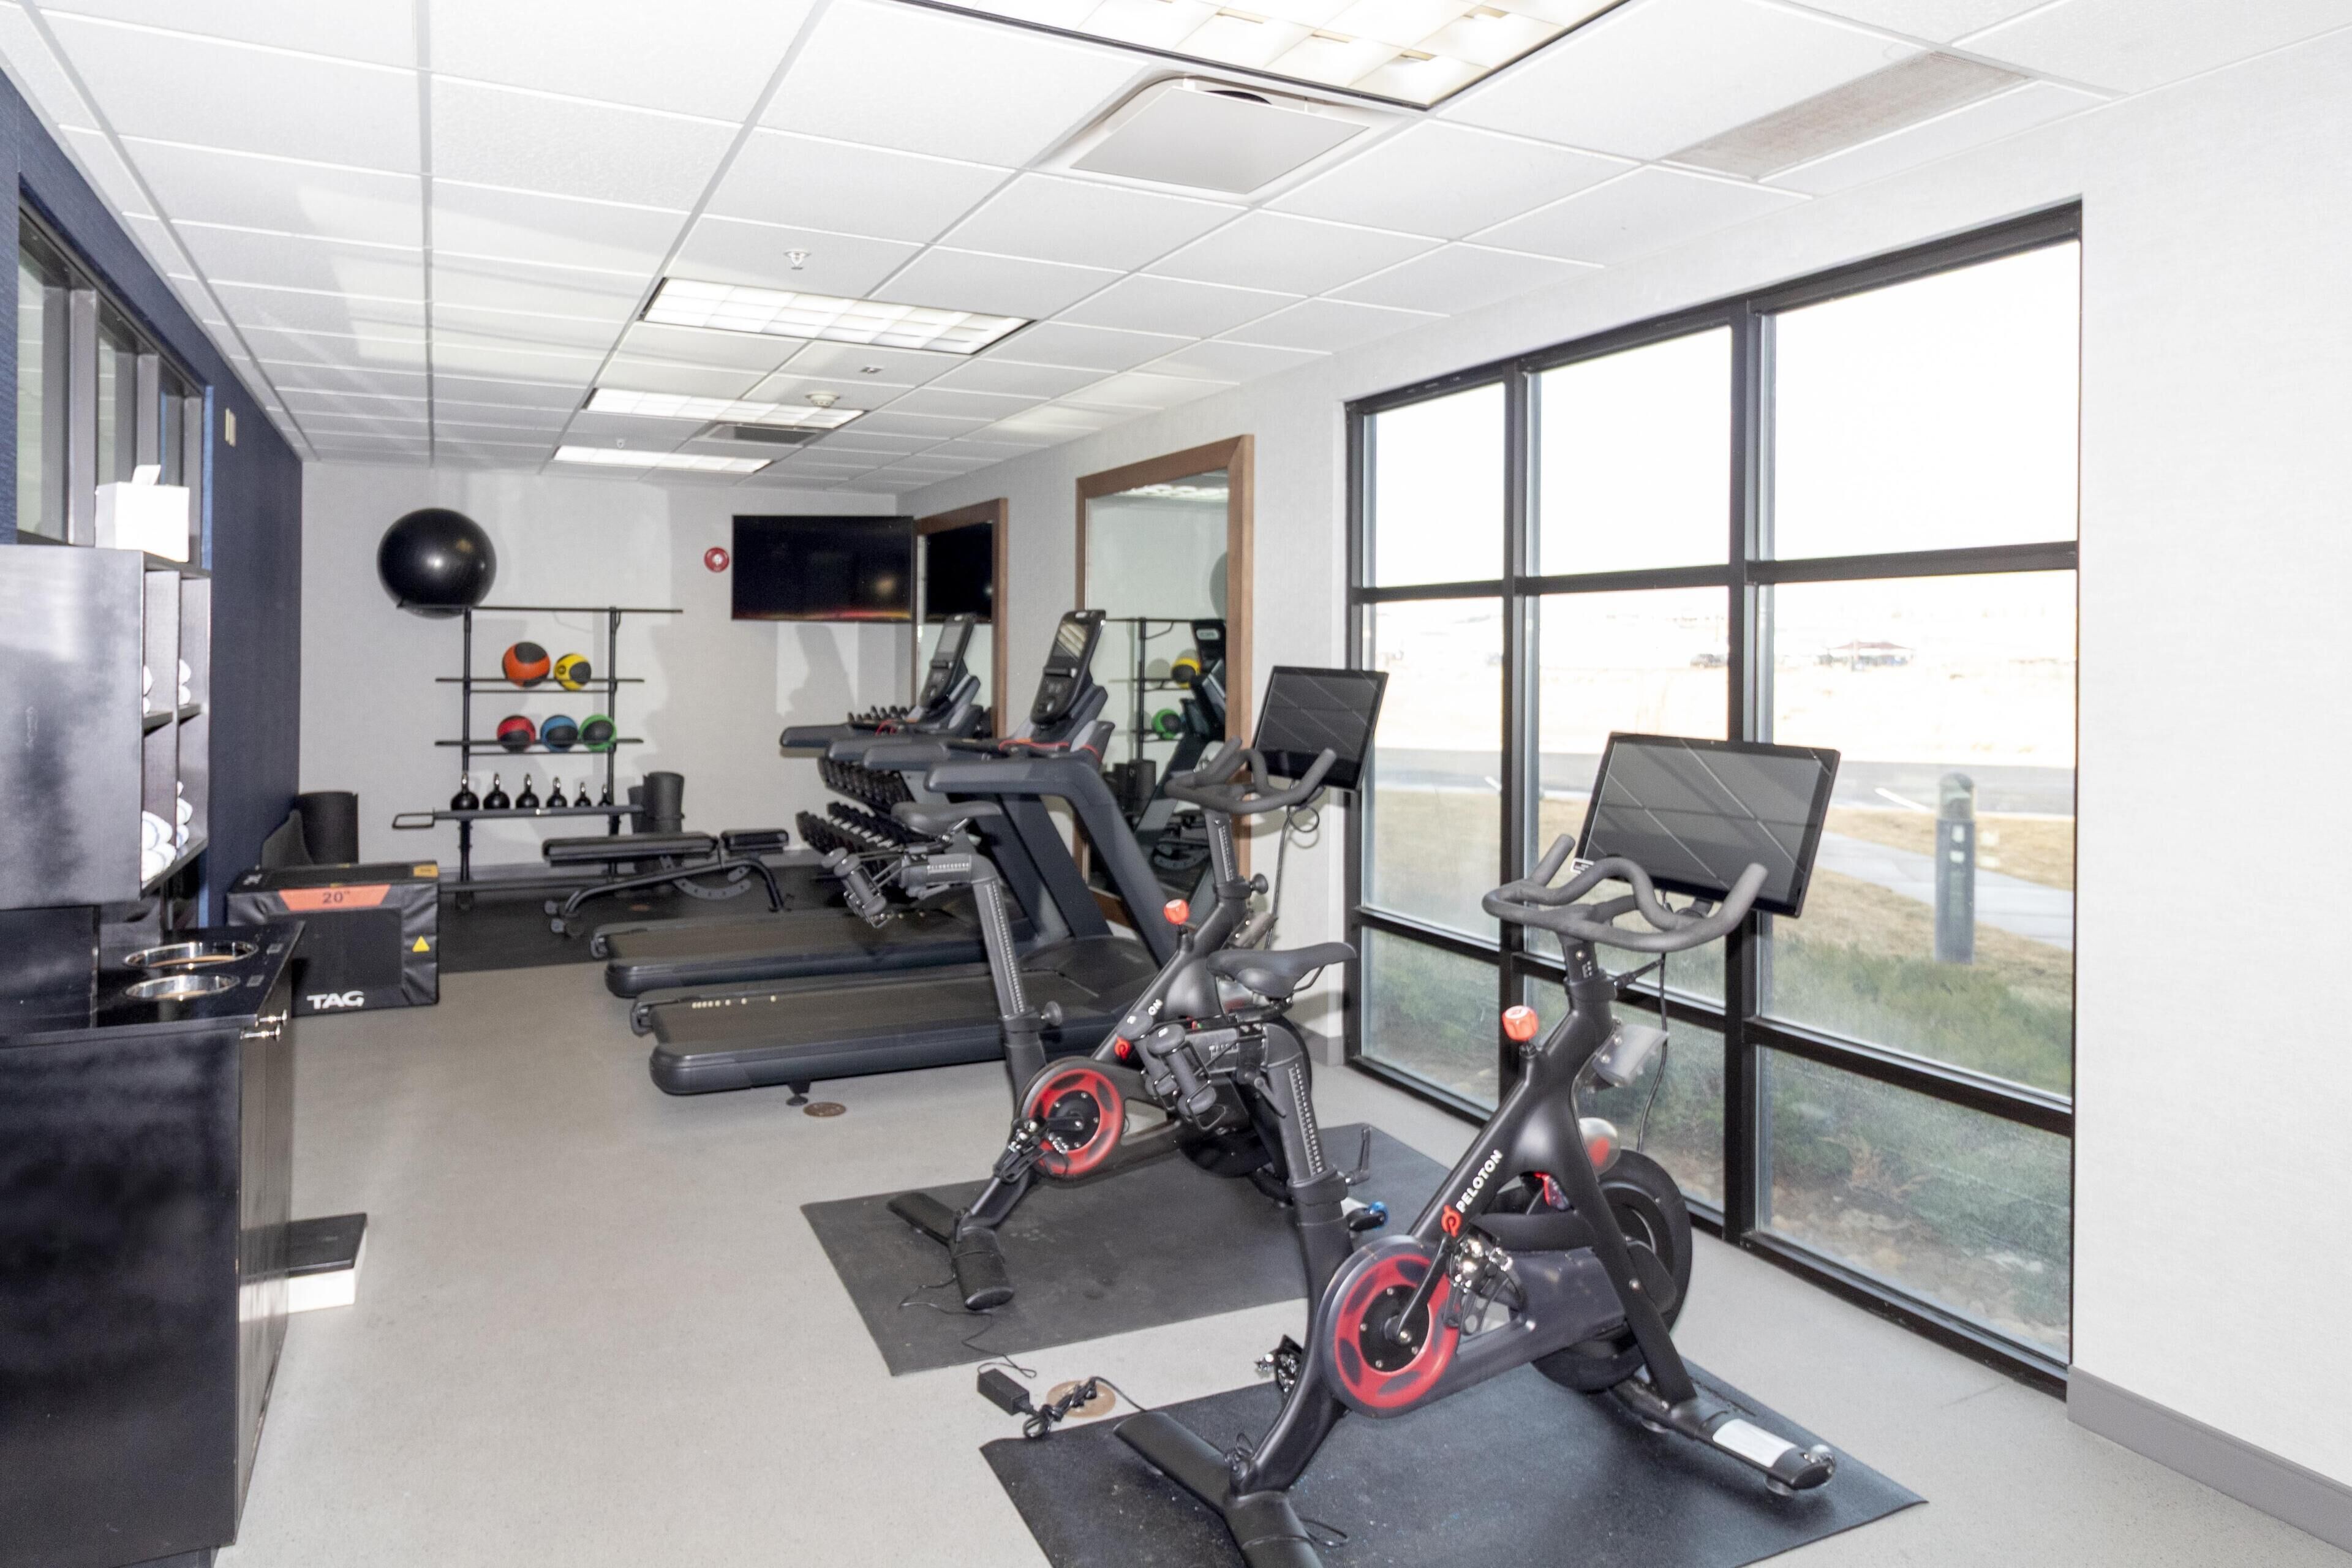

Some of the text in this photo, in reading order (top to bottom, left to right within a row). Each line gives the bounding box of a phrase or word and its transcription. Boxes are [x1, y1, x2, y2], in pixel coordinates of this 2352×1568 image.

[323, 891, 350, 903] 20"
[306, 990, 364, 1009] TAG
[1455, 1149, 1502, 1213] PELOTON
